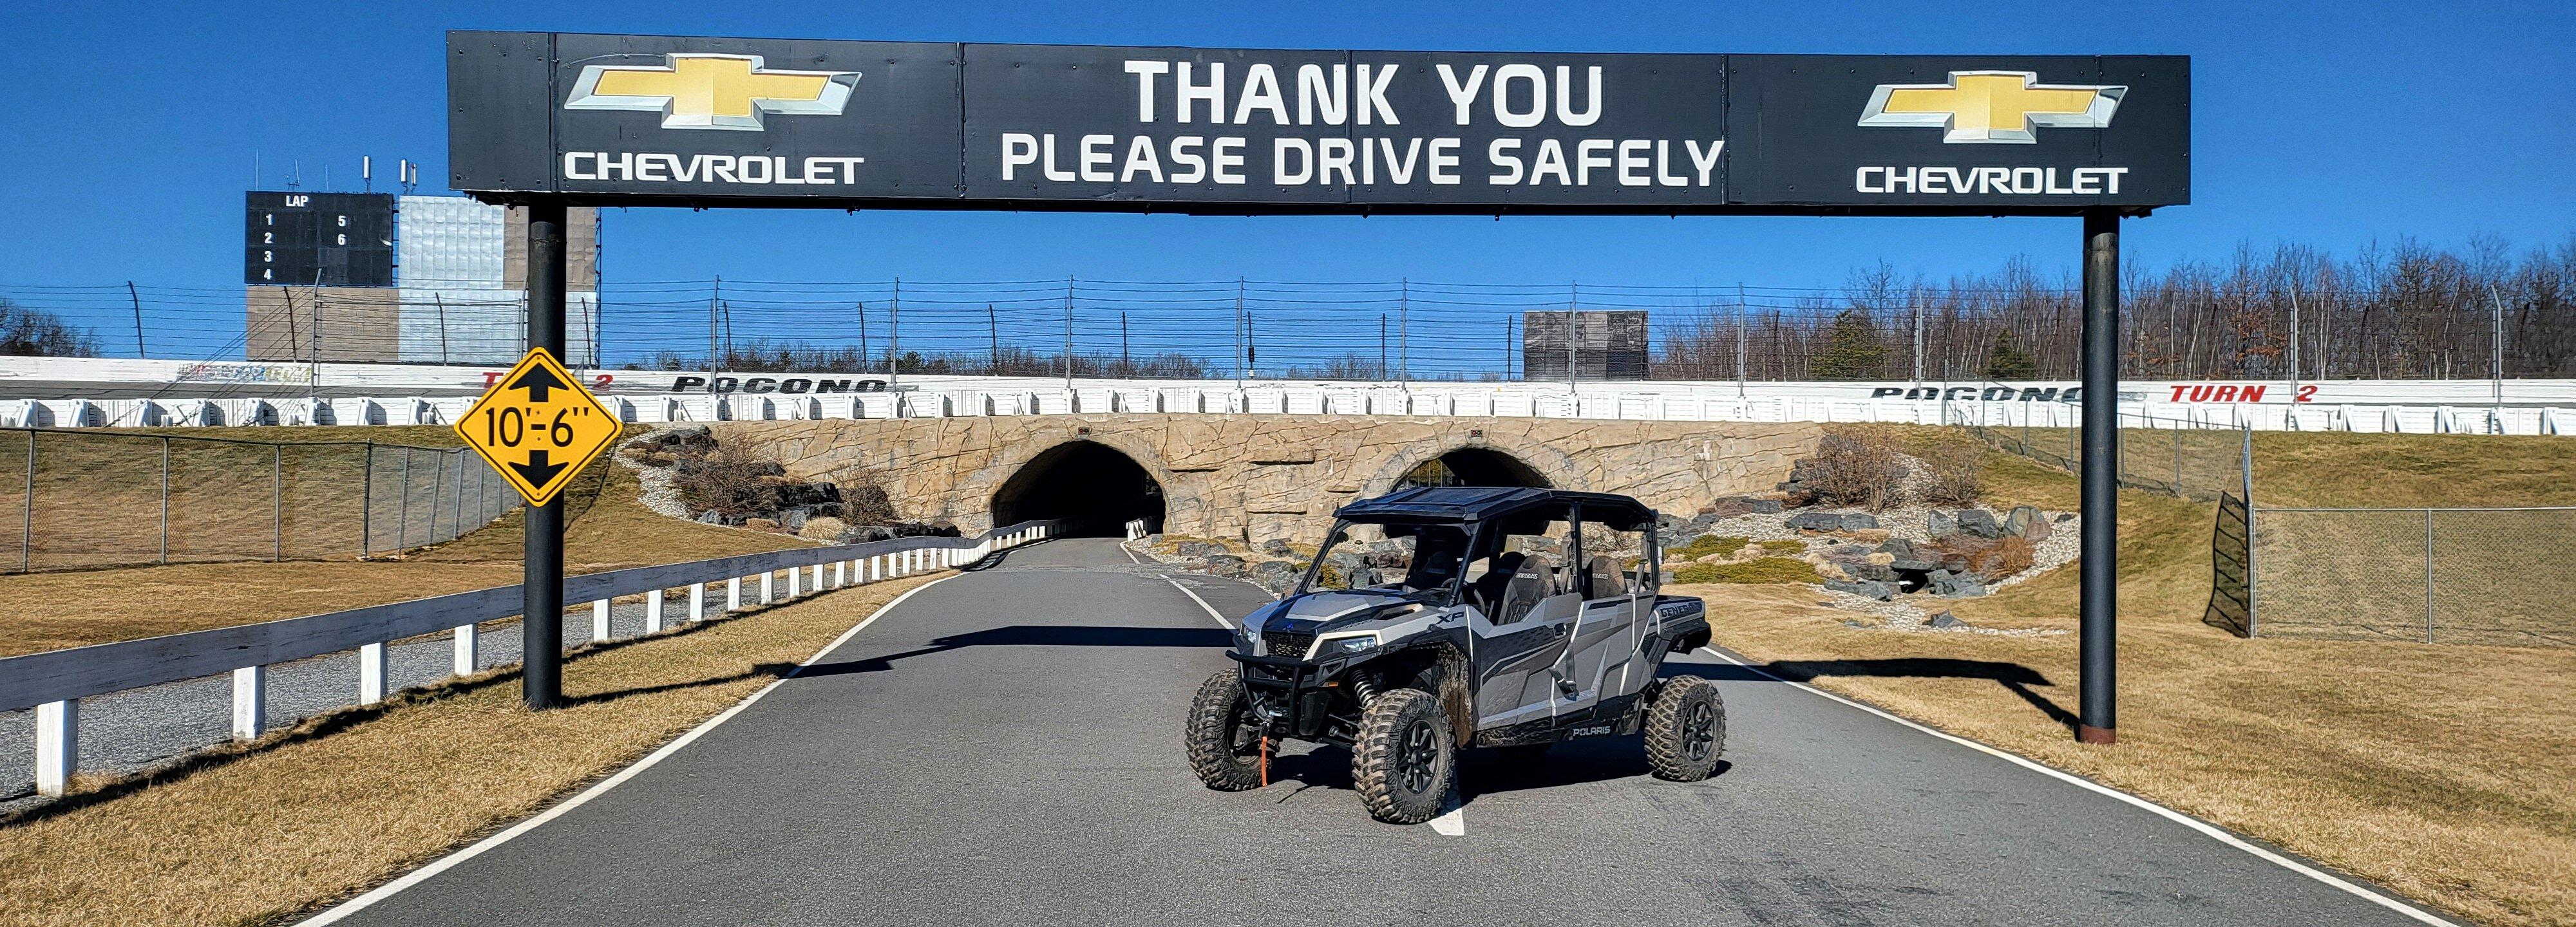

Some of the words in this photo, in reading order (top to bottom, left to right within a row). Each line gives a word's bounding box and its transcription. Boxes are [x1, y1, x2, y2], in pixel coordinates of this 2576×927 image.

[1124, 60, 1399, 125] THANK
[1436, 64, 1602, 127] YOU
[1002, 133, 1246, 184] PLEASE
[1274, 137, 1461, 185] DRIVE
[1488, 138, 1725, 187] SAFELY
[564, 151, 864, 185] CHEVROLET
[1856, 166, 2128, 194] CHEVROLET
[285, 195, 308, 207] LAP
[265, 214, 273, 225] 1
[338, 215, 347, 227] 5
[264, 232, 272, 244] 2
[337, 234, 346, 245] 6
[264, 250, 272, 263] 3
[263, 268, 272, 280] 4
[672, 377, 887, 393] POCONO
[2170, 385, 2266, 402] TURN
[2297, 385, 2318, 402] 2
[1435, 611, 1465, 625] XP
[1573, 726, 1611, 736] POLARIS
